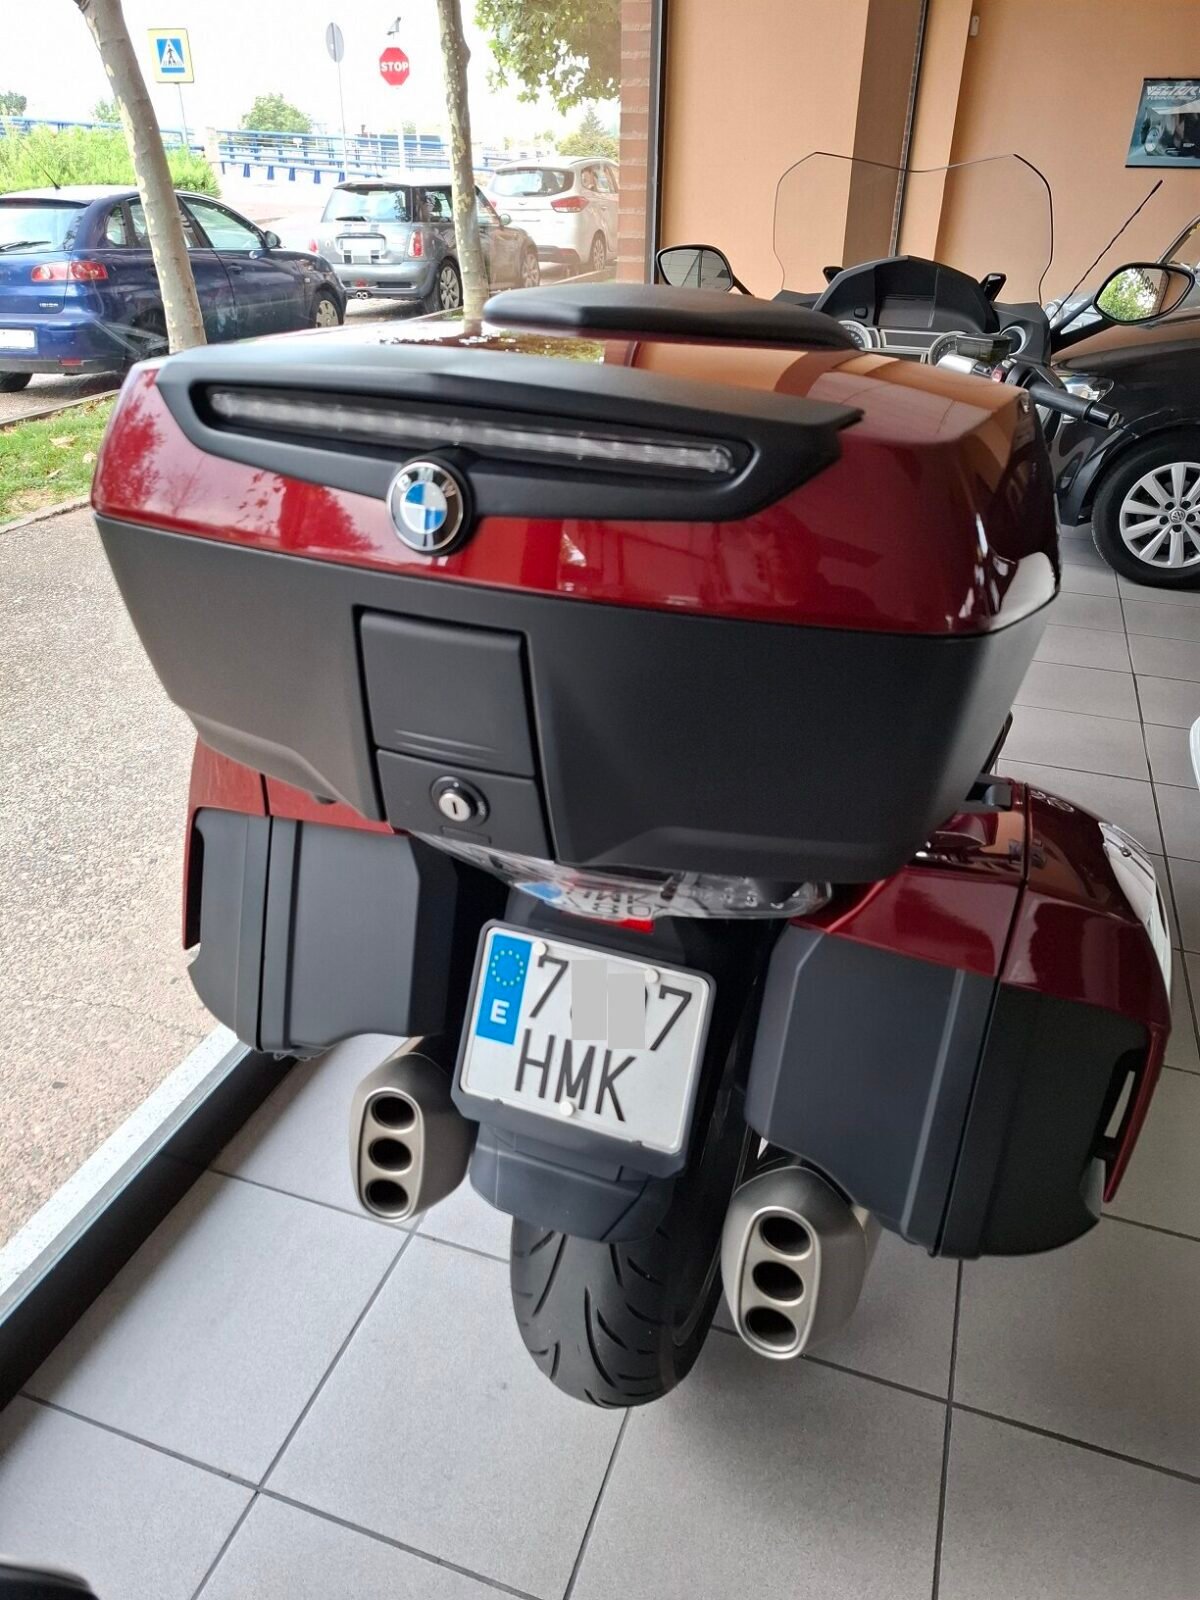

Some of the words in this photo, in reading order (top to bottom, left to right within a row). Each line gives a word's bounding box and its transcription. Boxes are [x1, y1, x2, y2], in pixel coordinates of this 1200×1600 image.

[380, 61, 409, 72] STOP
[490, 998, 510, 1025] E
[515, 1028, 637, 1122] HMK
